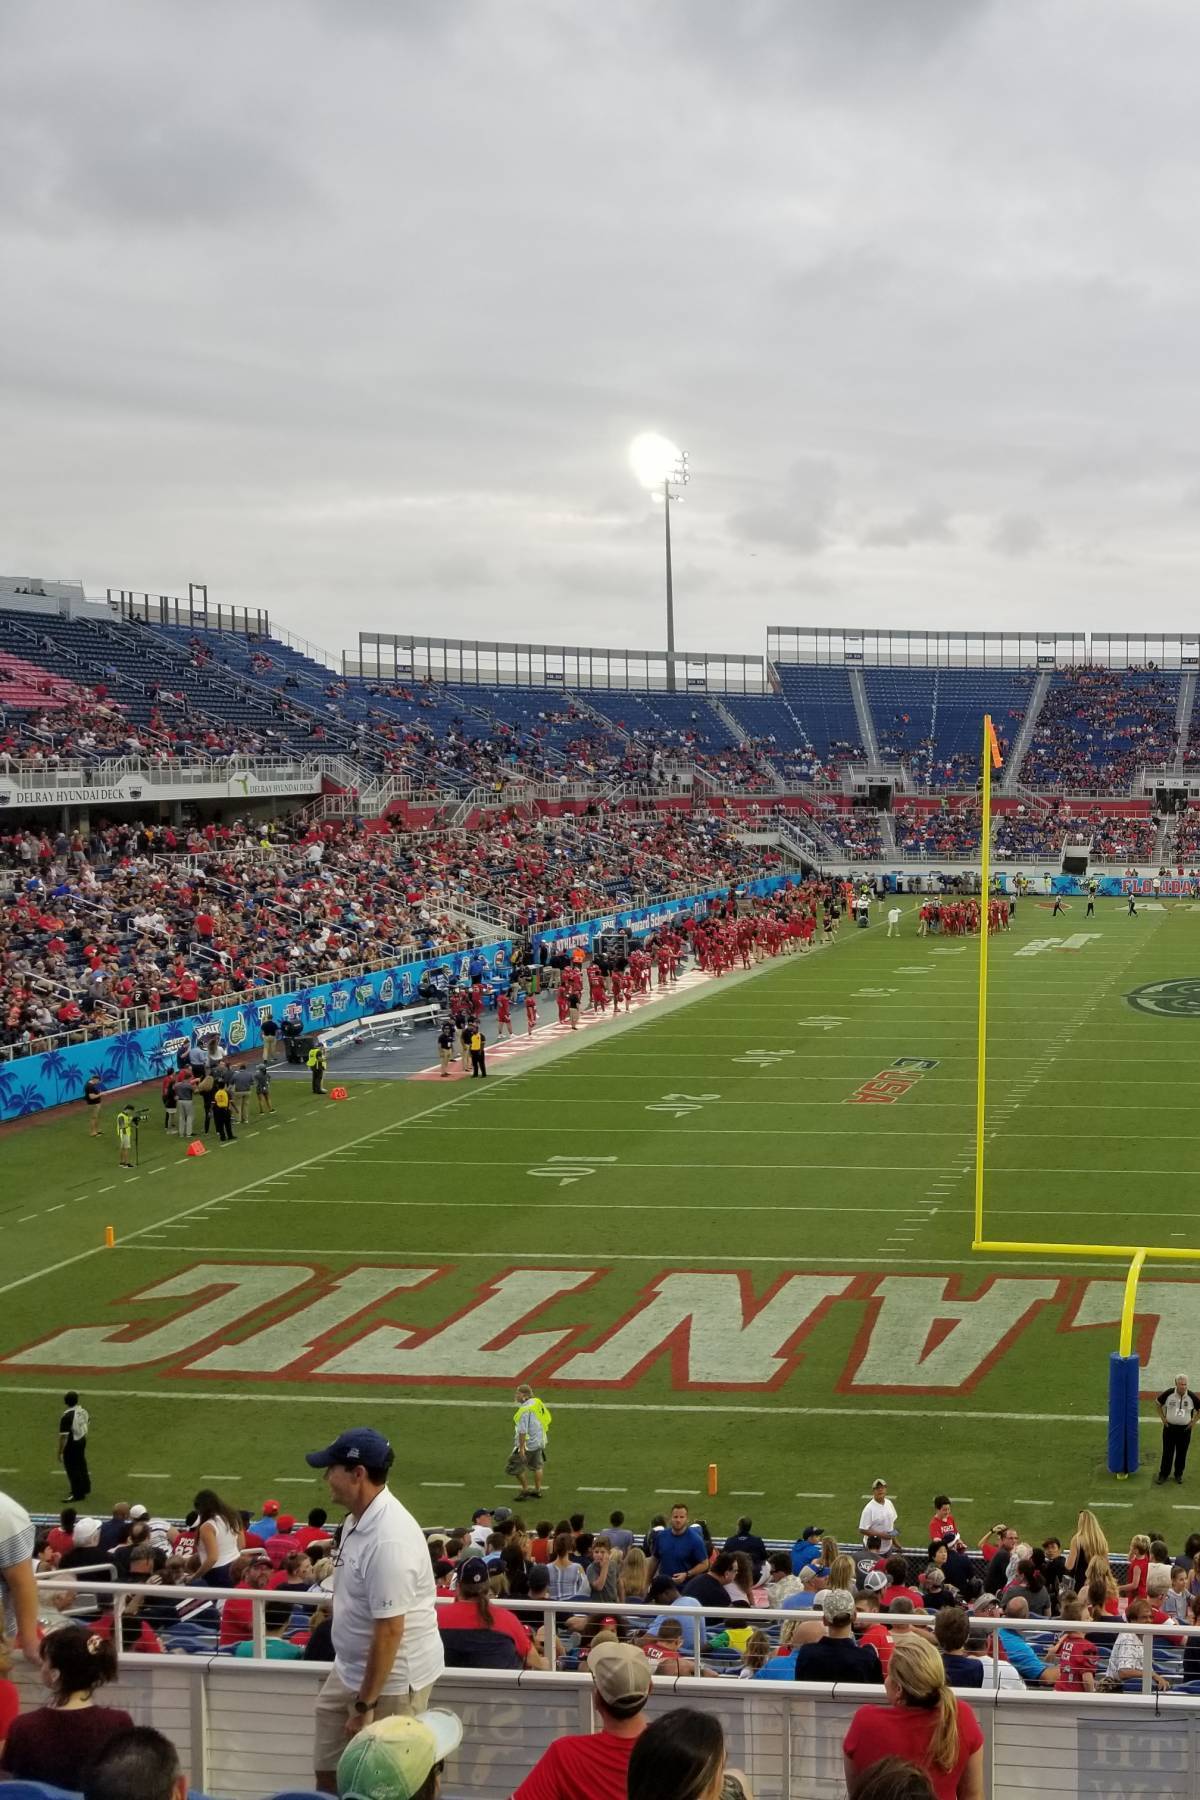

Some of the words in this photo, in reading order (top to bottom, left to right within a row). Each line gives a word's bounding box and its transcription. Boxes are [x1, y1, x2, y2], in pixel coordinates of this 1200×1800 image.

[16, 790, 54, 803] DELRAY
[56, 789, 99, 802] HYUNDAI
[100, 789, 125, 800] DECK
[1121, 879, 1192, 894] FLOIDA
[644, 1093, 722, 1113] 20
[526, 1154, 619, 1178] 10
